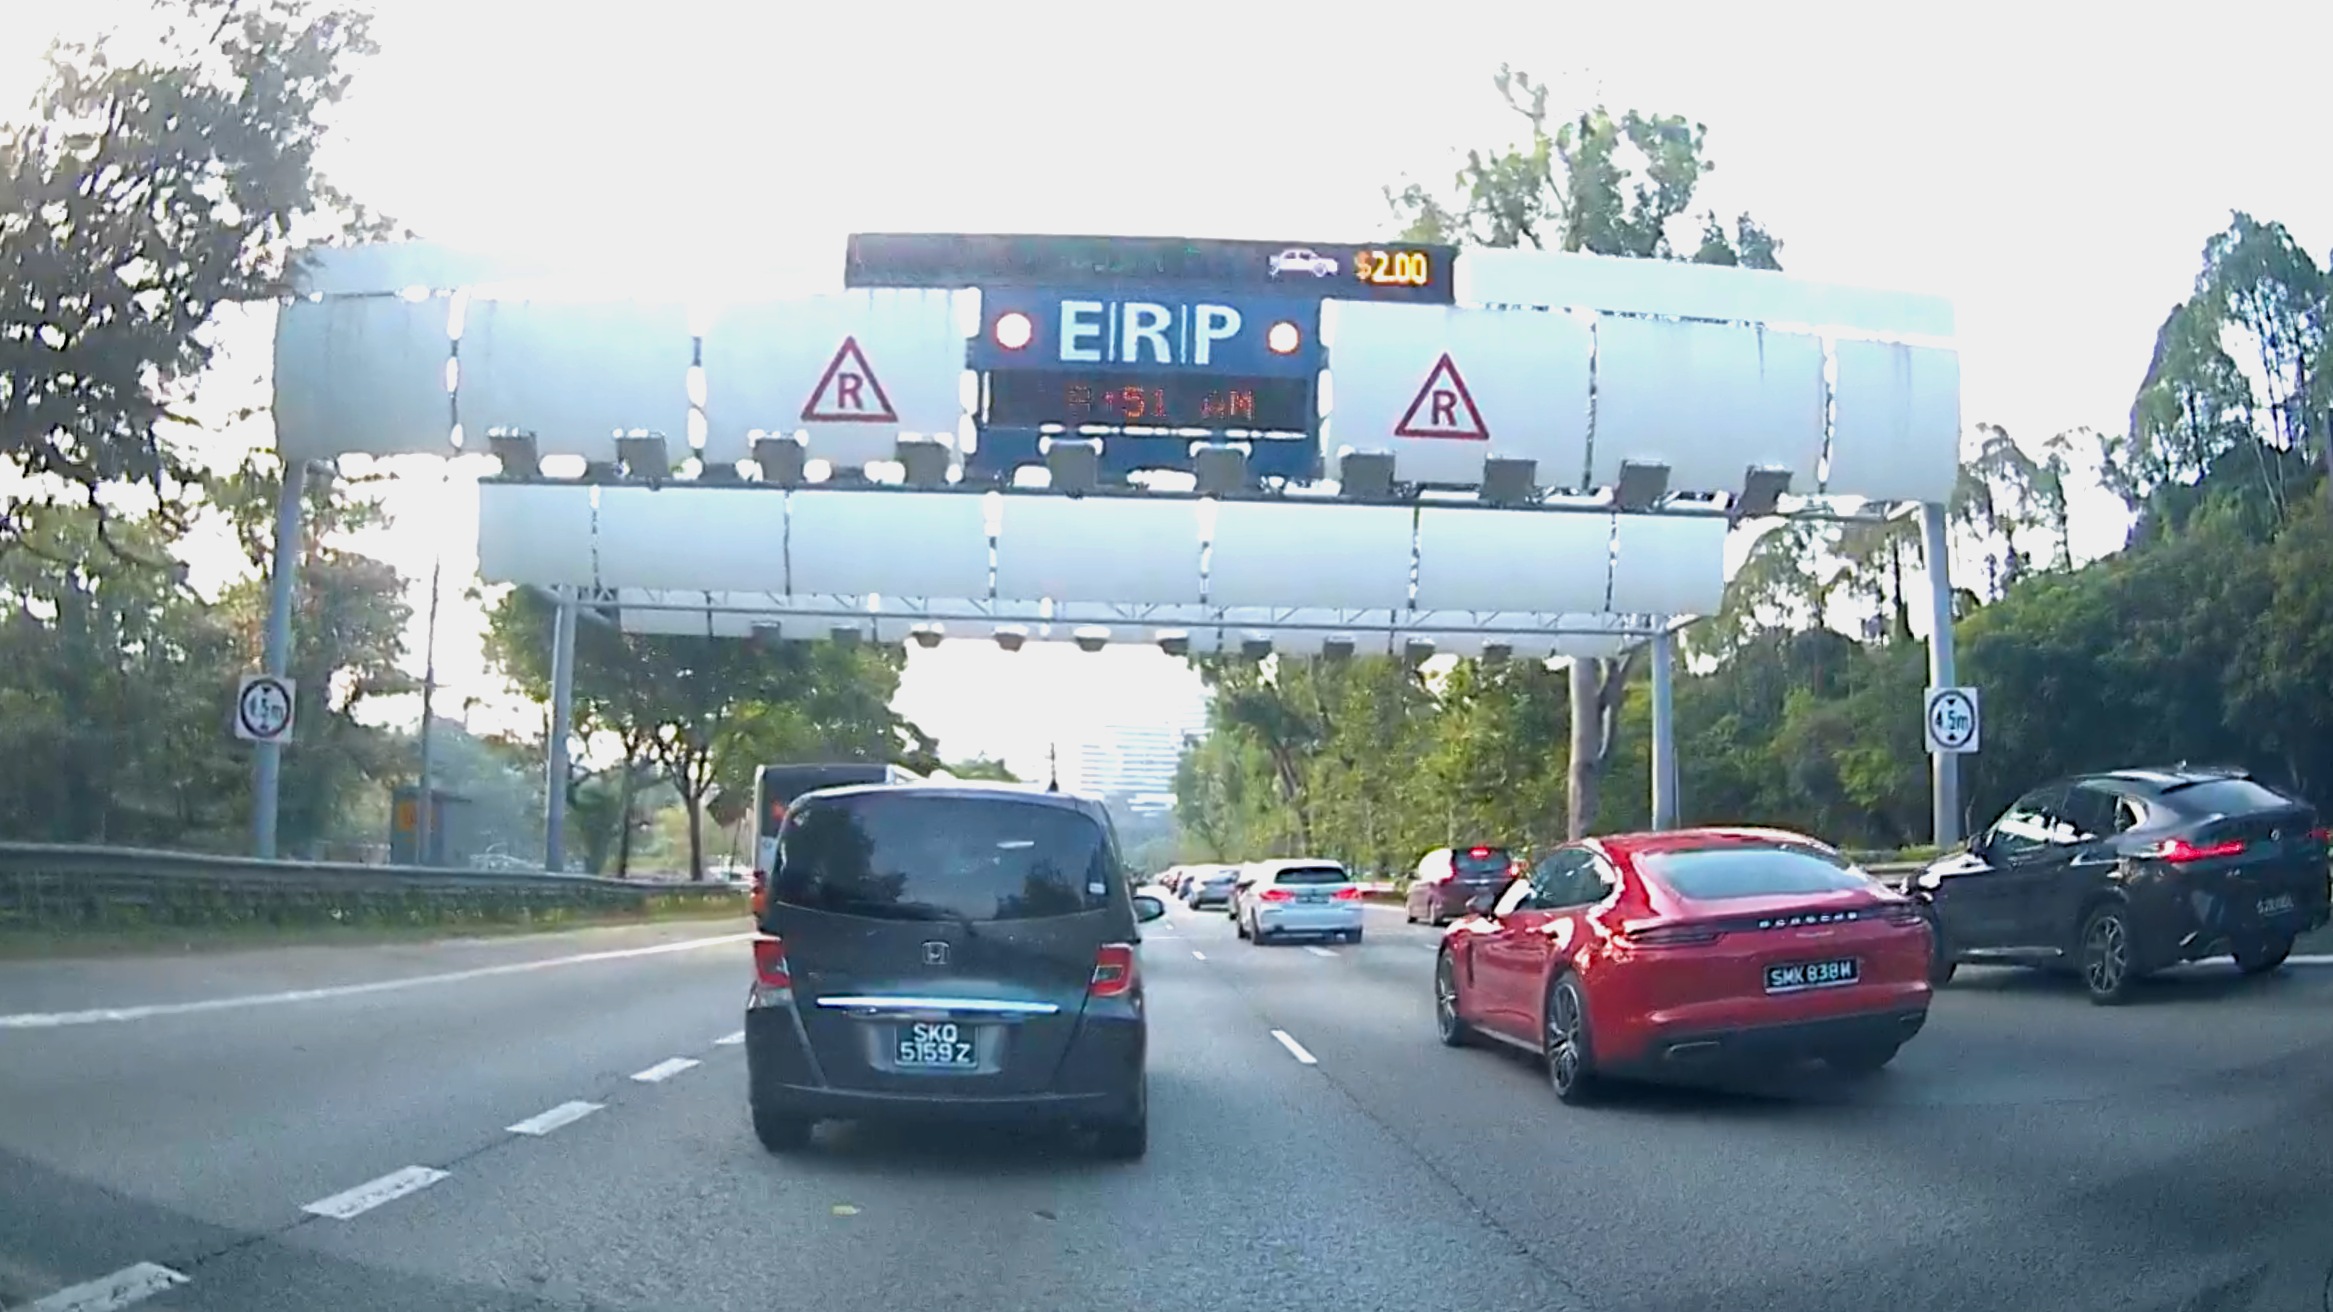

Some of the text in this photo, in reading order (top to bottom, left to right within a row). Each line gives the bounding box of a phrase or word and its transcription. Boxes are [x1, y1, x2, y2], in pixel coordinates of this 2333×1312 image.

[1354, 250, 1428, 285] $2.00
[837, 373, 864, 410] R
[1432, 390, 1457, 426] R
